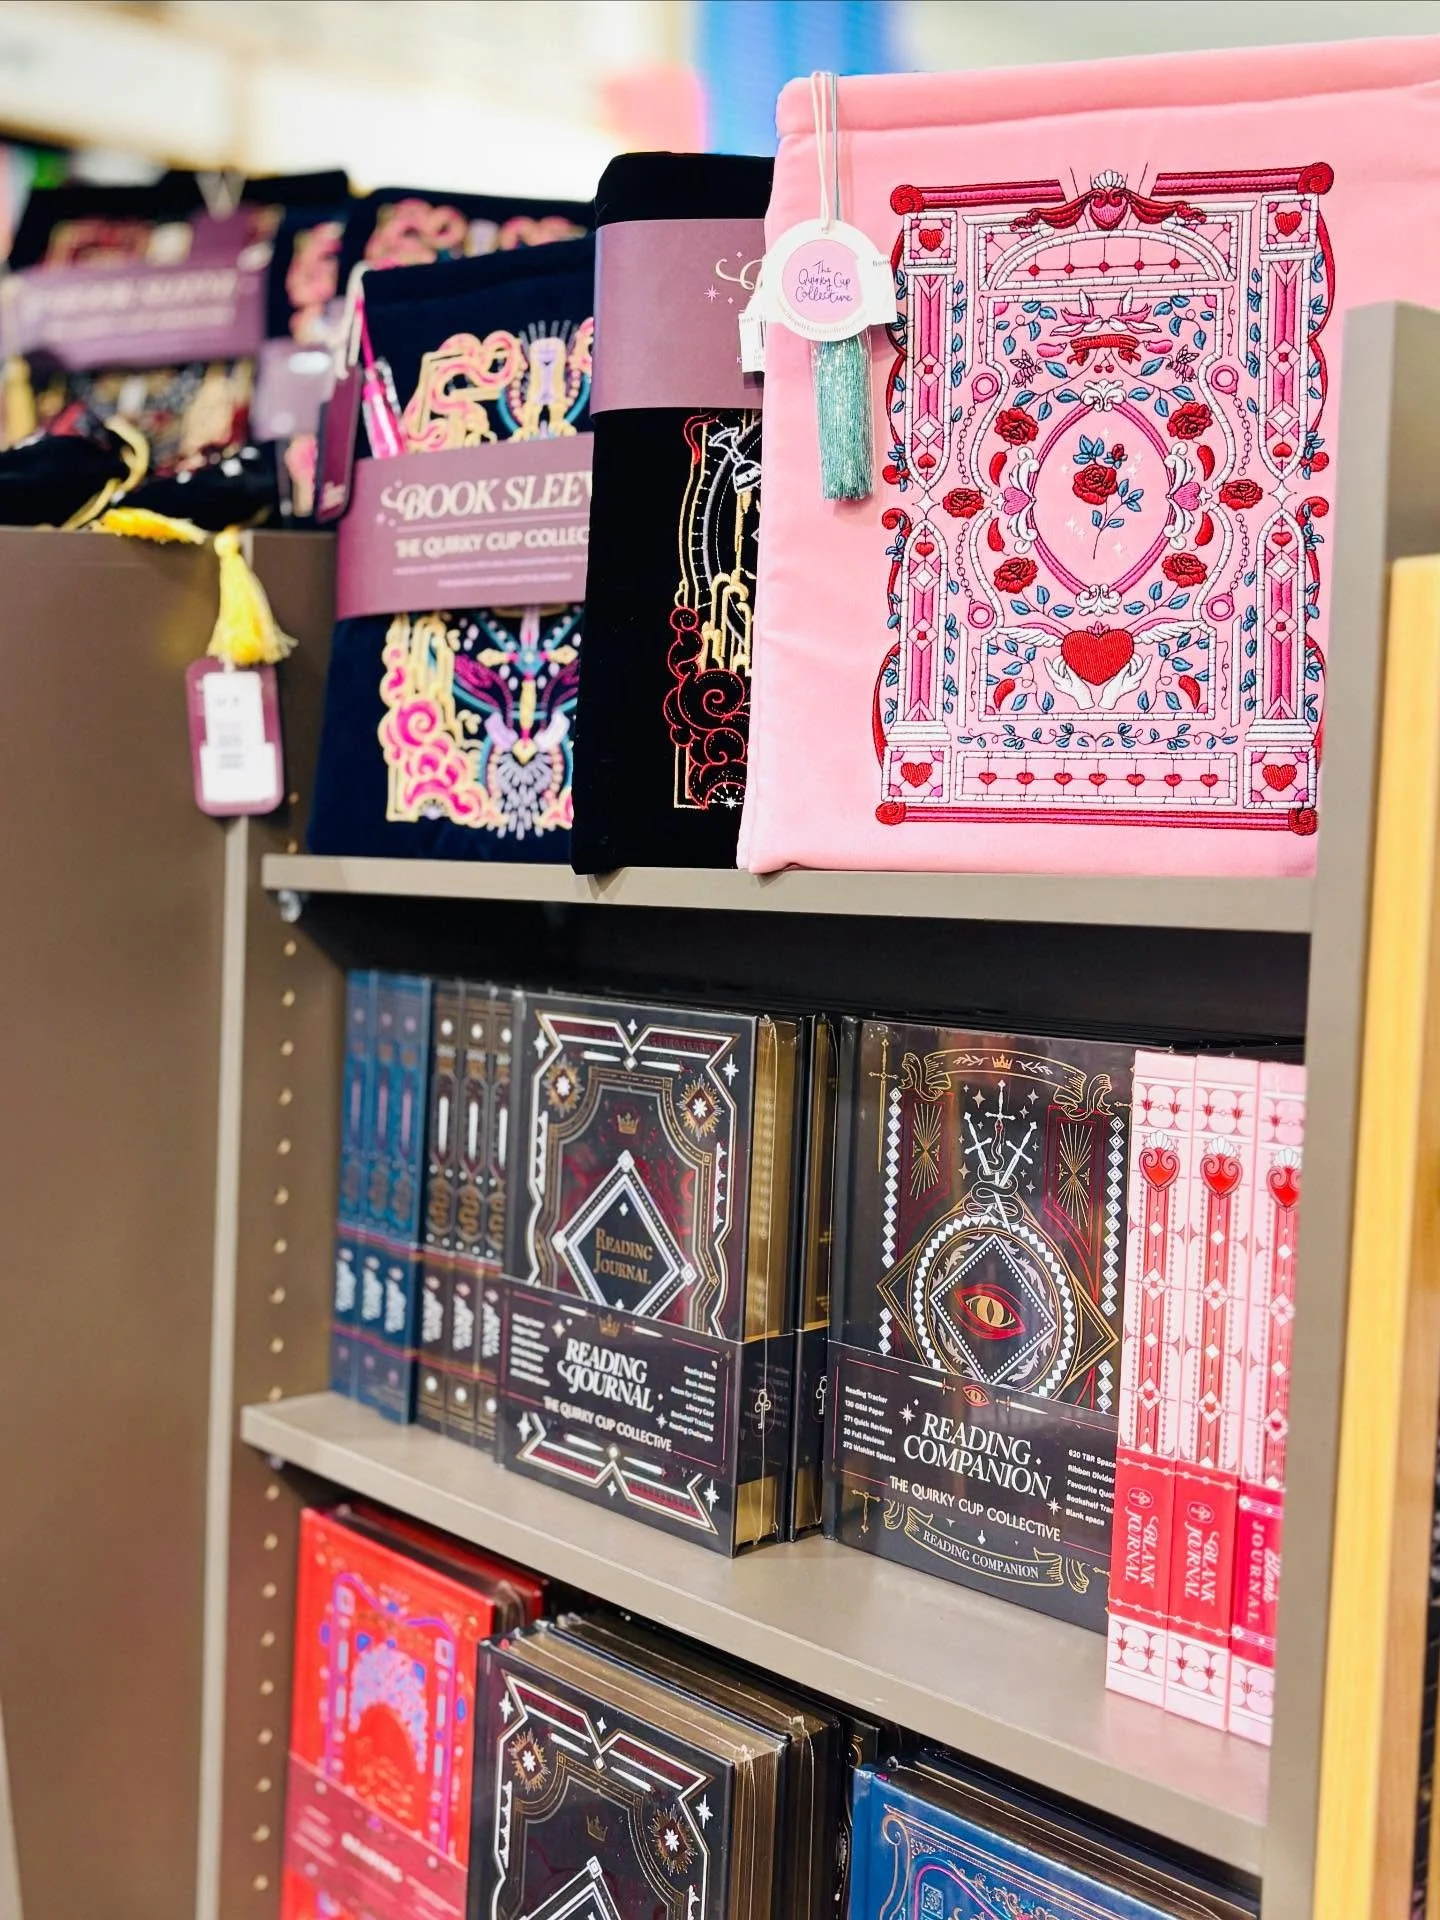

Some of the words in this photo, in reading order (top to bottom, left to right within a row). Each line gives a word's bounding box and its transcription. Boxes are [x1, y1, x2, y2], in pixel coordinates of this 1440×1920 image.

[812, 259, 831, 274] The
[834, 272, 850, 289] Cup
[380, 478, 501, 521] BOOK
[395, 538, 422, 559] THE
[486, 530, 523, 551] CUP
[596, 1227, 653, 1260] READING
[593, 1250, 651, 1284] JOURNAL
[565, 1338, 647, 1383] READING
[557, 1360, 654, 1412] JOURNAL
[845, 1386, 866, 1399] Reading
[543, 1396, 559, 1413] THE
[595, 1414, 614, 1431] CUP
[616, 1422, 672, 1452] COLLECTIVE
[854, 1417, 869, 1427] Quick
[868, 1406, 884, 1416] Paper
[852, 1430, 861, 1439] Full
[922, 1412, 1031, 1465] READING
[904, 1434, 1052, 1500] COMPANION
[1082, 1452, 1095, 1462] TBR
[1066, 1494, 1098, 1509] Bookshelf
[1067, 1480, 1097, 1494] Favourite
[889, 1476, 908, 1492] THE
[912, 1481, 955, 1508] QUIRKY
[958, 1498, 984, 1517] CUP
[987, 1508, 1061, 1542] COLLECTIVE
[1066, 1508, 1084, 1520] Blank
[923, 1530, 970, 1562] READING
[972, 1553, 1039, 1579] COMPANION
[1125, 1506, 1142, 1582] JOURNAL
[1140, 1516, 1159, 1588] BLANK
[1184, 1522, 1203, 1599] JOURNAL
[1201, 1531, 1219, 1606] BLANK
[1248, 1522, 1265, 1622] JOURNAL
